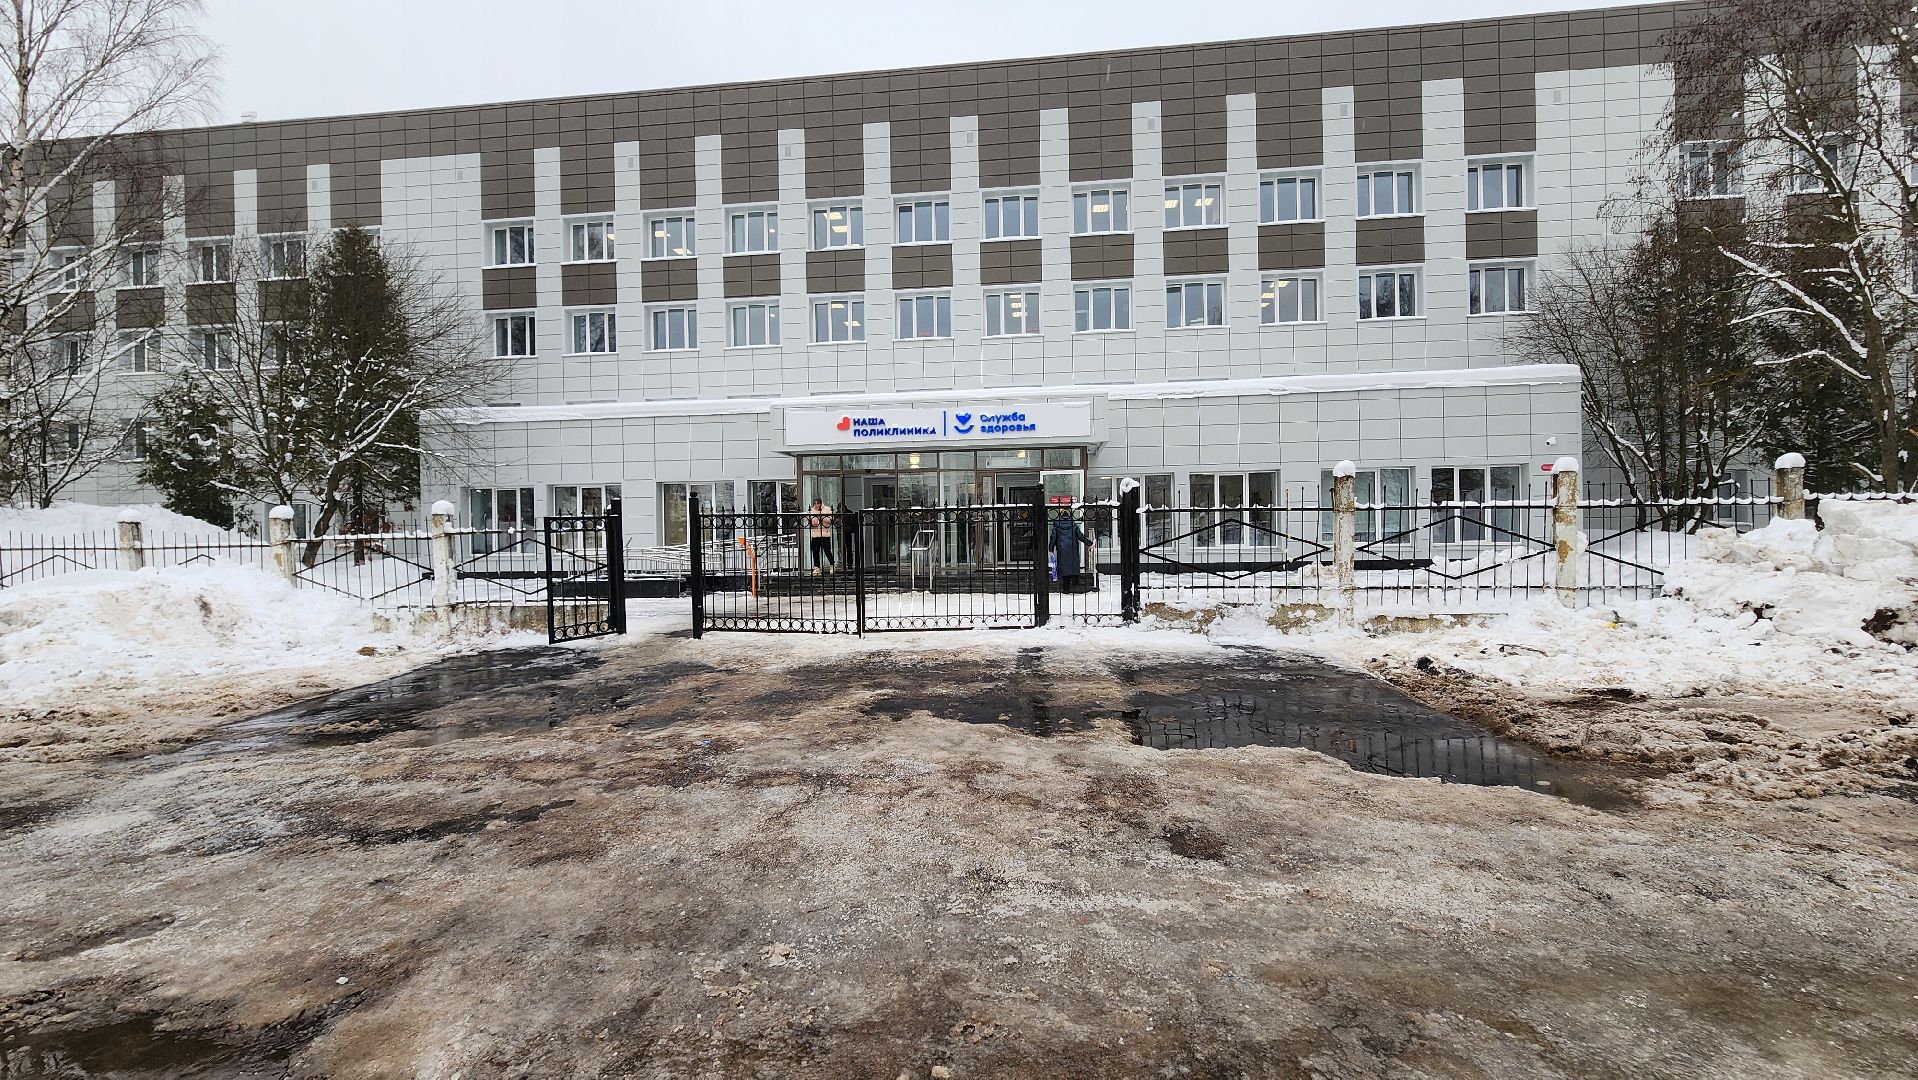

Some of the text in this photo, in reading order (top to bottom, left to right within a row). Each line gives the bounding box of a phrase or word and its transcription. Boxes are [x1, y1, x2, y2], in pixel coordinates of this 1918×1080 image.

[853, 418, 886, 426] НАША
[980, 412, 1026, 424] Служба
[853, 427, 937, 437] ПОЛИКЛИНИКА
[980, 423, 1036, 434] здоровья
